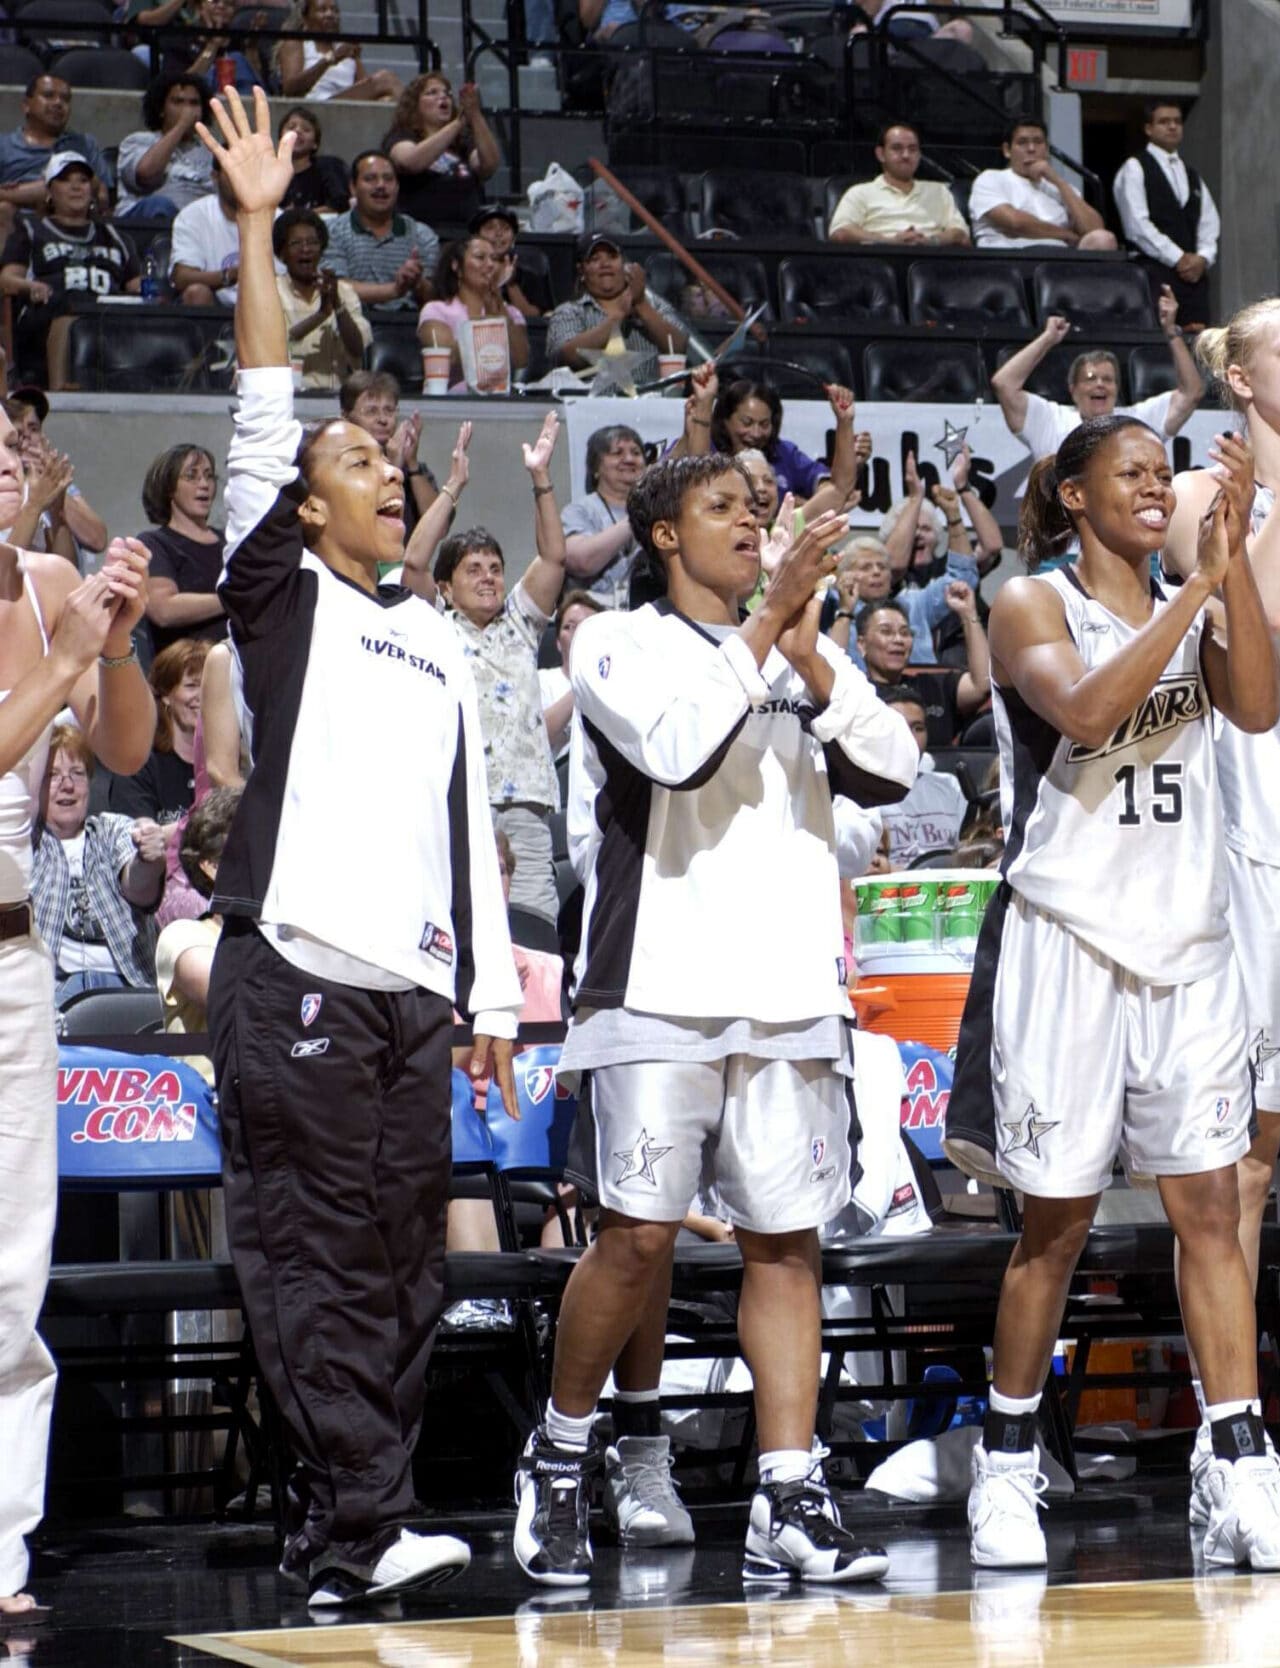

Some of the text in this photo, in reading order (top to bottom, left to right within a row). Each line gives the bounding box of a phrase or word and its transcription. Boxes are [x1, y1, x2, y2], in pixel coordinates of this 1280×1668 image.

[1069, 51, 1098, 82] XIT
[1114, 764, 1183, 825] 15
[71, 1102, 197, 1143] .COM
[536, 1460, 582, 1472] Reebok
